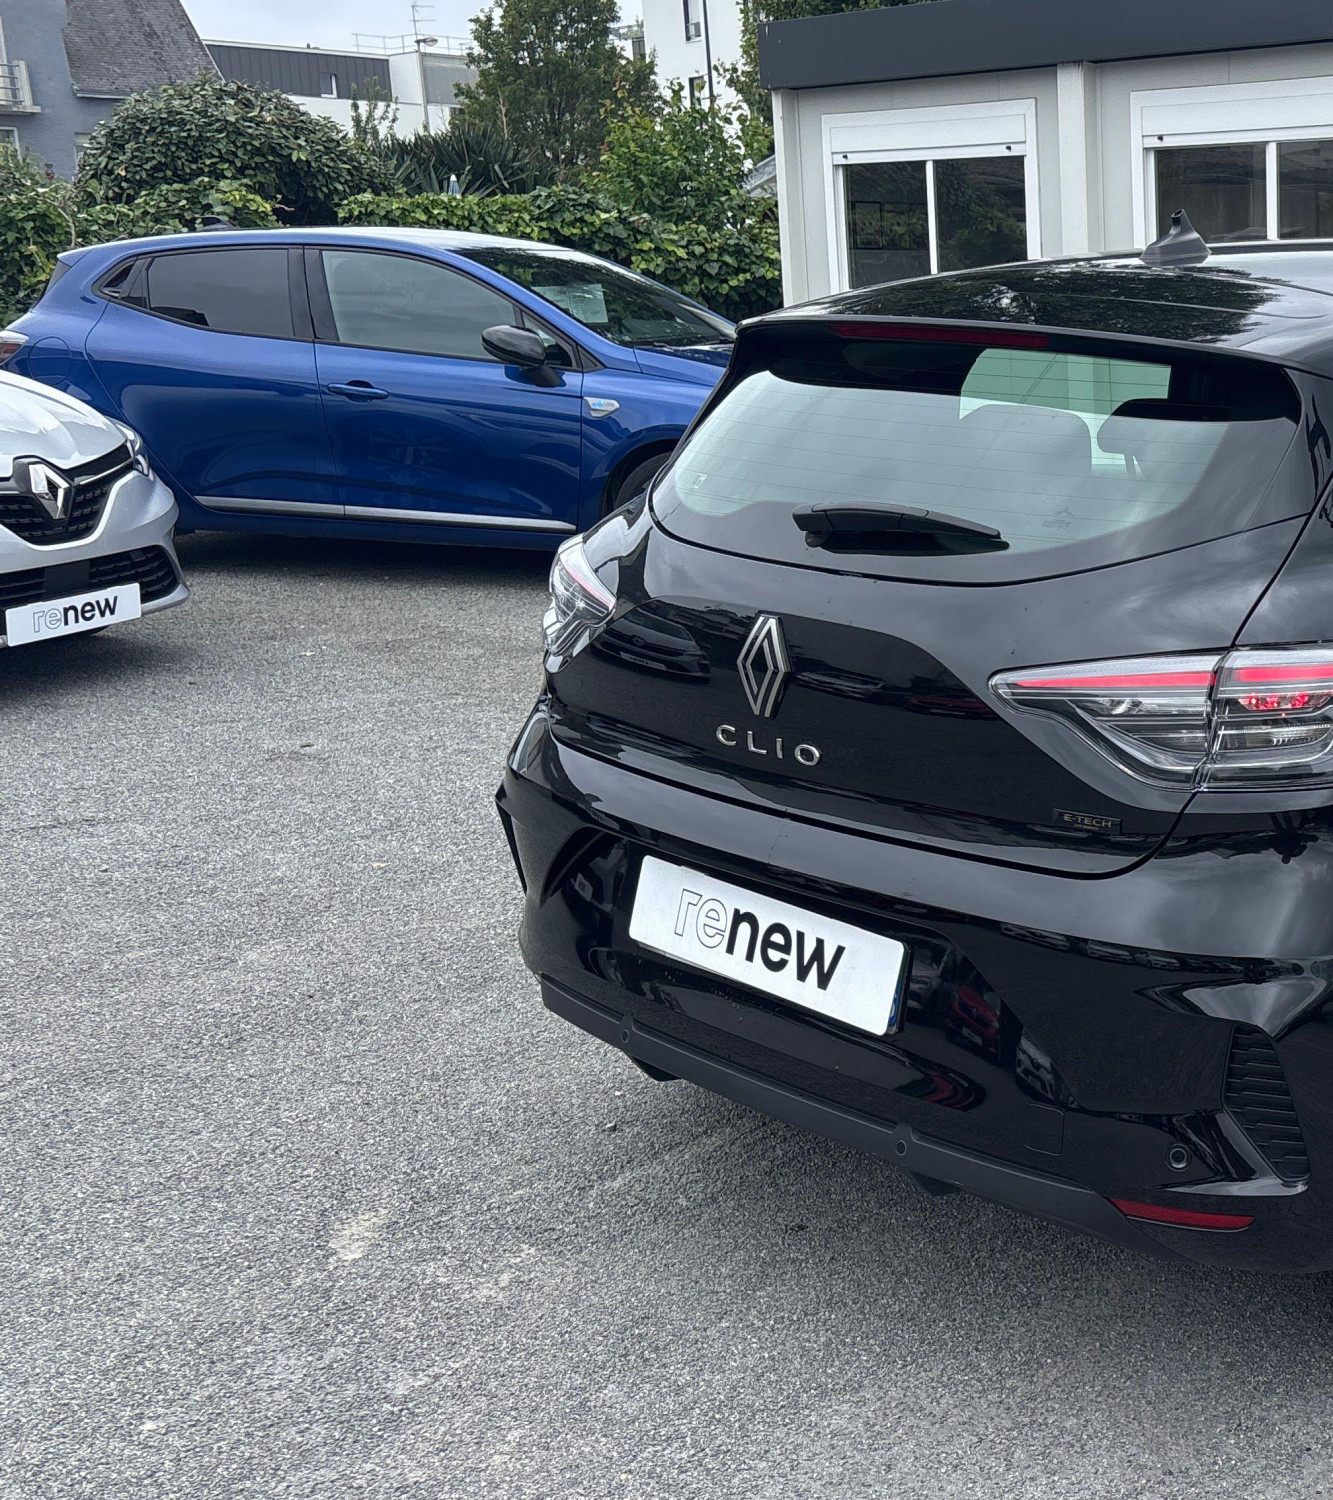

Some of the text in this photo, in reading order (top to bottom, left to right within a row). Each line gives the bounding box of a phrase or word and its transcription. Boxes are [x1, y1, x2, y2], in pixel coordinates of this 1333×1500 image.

[32, 595, 118, 633] renew
[716, 724, 820, 767] CLIO
[1063, 813, 1112, 828] E-TECH
[674, 888, 846, 991] renew
